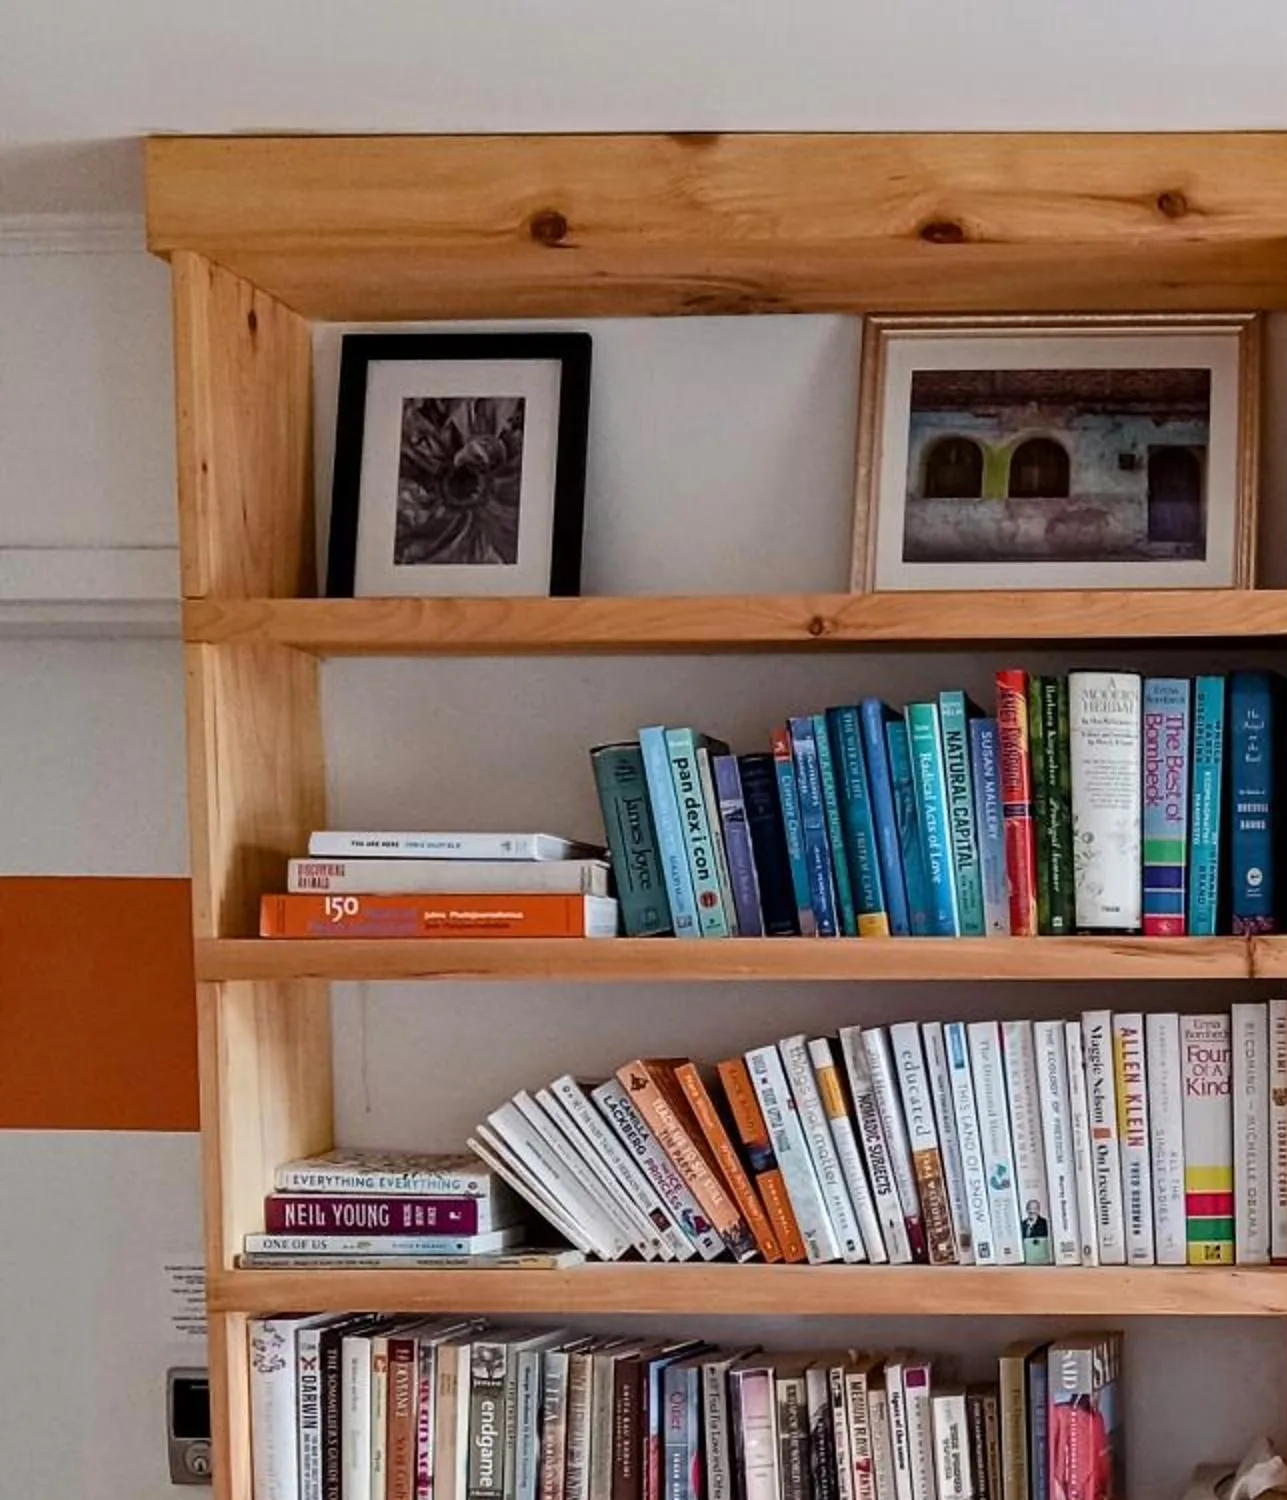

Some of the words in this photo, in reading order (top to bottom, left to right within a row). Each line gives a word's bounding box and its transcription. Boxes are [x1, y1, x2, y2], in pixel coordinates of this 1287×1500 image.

[981, 731, 993, 777] SUSAN
[1166, 713, 1184, 752] The
[674, 758, 692, 792] pan
[920, 752, 934, 801] Radical
[946, 730, 967, 801] NATURAL
[1146, 713, 1163, 807] Bombeck
[1166, 756, 1184, 793] Best
[623, 798, 646, 844] James
[681, 798, 700, 832] dex
[925, 805, 938, 832] Acts
[984, 782, 998, 839] MALLERY
[1166, 797, 1184, 822] of
[928, 837, 939, 849] of
[954, 808, 977, 871] CAPITAL
[632, 848, 652, 890] Joyce
[694, 848, 711, 880] con
[929, 852, 943, 884] Love
[325, 896, 359, 922] 150
[1088, 1025, 1103, 1075] Maggie
[1119, 1027, 1140, 1083] ALLEN
[1187, 1046, 1232, 1062] Four
[1245, 1022, 1255, 1096] BECOMING
[901, 1050, 931, 1137] educated
[1047, 1051, 1060, 1096] ECOLOGY
[1186, 1076, 1232, 1096] Kind
[858, 1094, 882, 1143] NOMADIC
[958, 1083, 969, 1111] THIS
[1093, 1078, 1106, 1123] Nelson
[618, 1098, 649, 1143] CAMILLA
[961, 1115, 973, 1151] LAND
[1125, 1094, 1144, 1147] KLEIN
[966, 1156, 978, 1173] OF
[1097, 1144, 1109, 1165] On
[1246, 1115, 1257, 1182] MICHELLE
[292, 1175, 375, 1188] EVERYTHING
[379, 1179, 461, 1190] EVERYTHING
[868, 1145, 891, 1196] SUBJECTS
[284, 1203, 325, 1227] NEIL
[331, 1203, 389, 1227] YOUNG
[970, 1179, 984, 1224] SNOW
[1099, 1167, 1110, 1226] Freedom
[1247, 1187, 1257, 1238] OBAMA
[262, 1240, 290, 1249] ONE
[292, 1239, 307, 1249] OF
[311, 1239, 327, 1249] US
[327, 1348, 337, 1370] THE
[302, 1375, 317, 1429] DARWIN
[850, 1381, 865, 1425] MEDIUM
[327, 1448, 338, 1480] GUIDE
[476, 1401, 498, 1488] endgame
[710, 1432, 723, 1454] Love
[327, 1486, 338, 1500] TO
